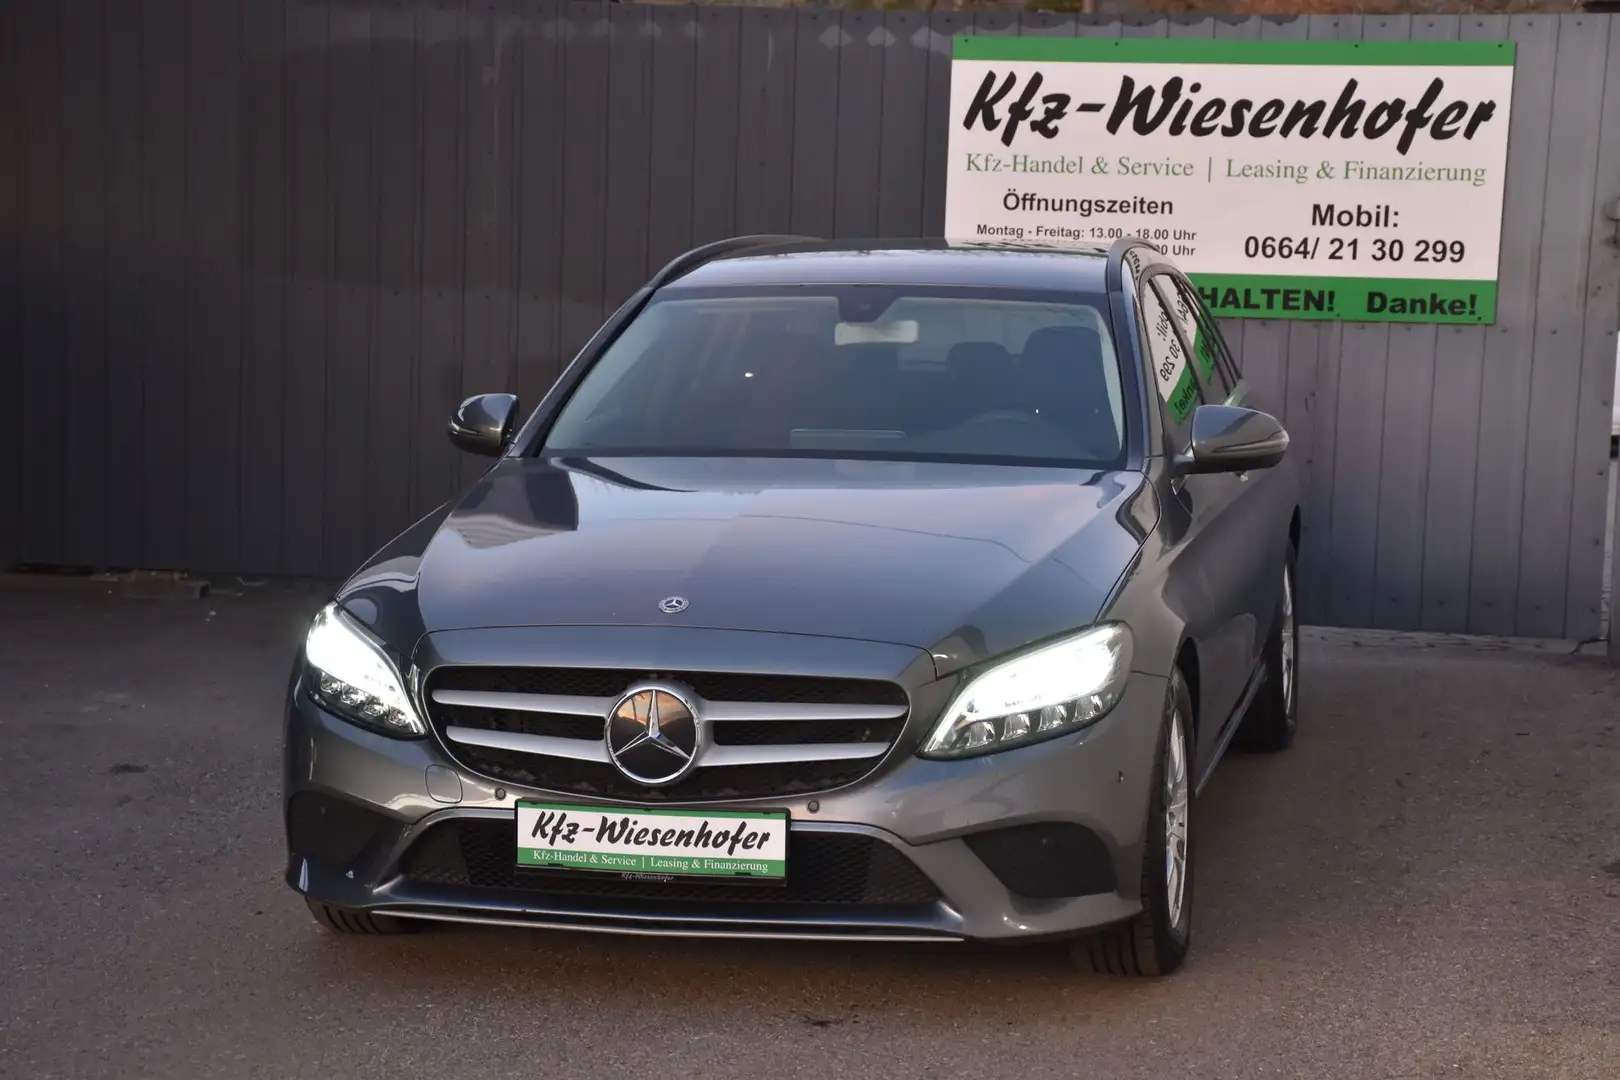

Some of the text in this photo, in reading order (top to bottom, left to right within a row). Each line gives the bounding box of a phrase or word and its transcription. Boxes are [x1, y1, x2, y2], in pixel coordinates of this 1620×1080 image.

[962, 70, 1496, 156] Kfz-Wiesenhofer
[965, 153, 1084, 176] Kfz-Handel
[1091, 156, 1110, 176] &
[1117, 156, 1195, 177] Service
[1226, 158, 1309, 185] Leasing
[1316, 161, 1336, 181] &
[1343, 161, 1486, 187] Finanzierung
[1003, 189, 1174, 217] Öffnungszeiten
[1311, 203, 1399, 228] Mobil:
[976, 223, 1025, 240] Montag
[1035, 225, 1085, 241] Freitag:
[1090, 228, 1123, 239] 13.00
[1136, 228, 1169, 240] 18.00
[1173, 229, 1197, 241] Uhr
[1172, 245, 1197, 257] Uhr
[1244, 236, 1465, 264] 0664/ 21 30 299
[1366, 291, 1477, 316] Danke!
[531, 810, 771, 856] Kfz-Wiesenhofer
[533, 849, 587, 864] Kfz-Handel
[589, 853, 598, 864] &
[601, 854, 637, 866] Service
[650, 857, 689, 873] Leasing
[691, 859, 701, 870] &
[704, 859, 769, 873] Finanzierung
